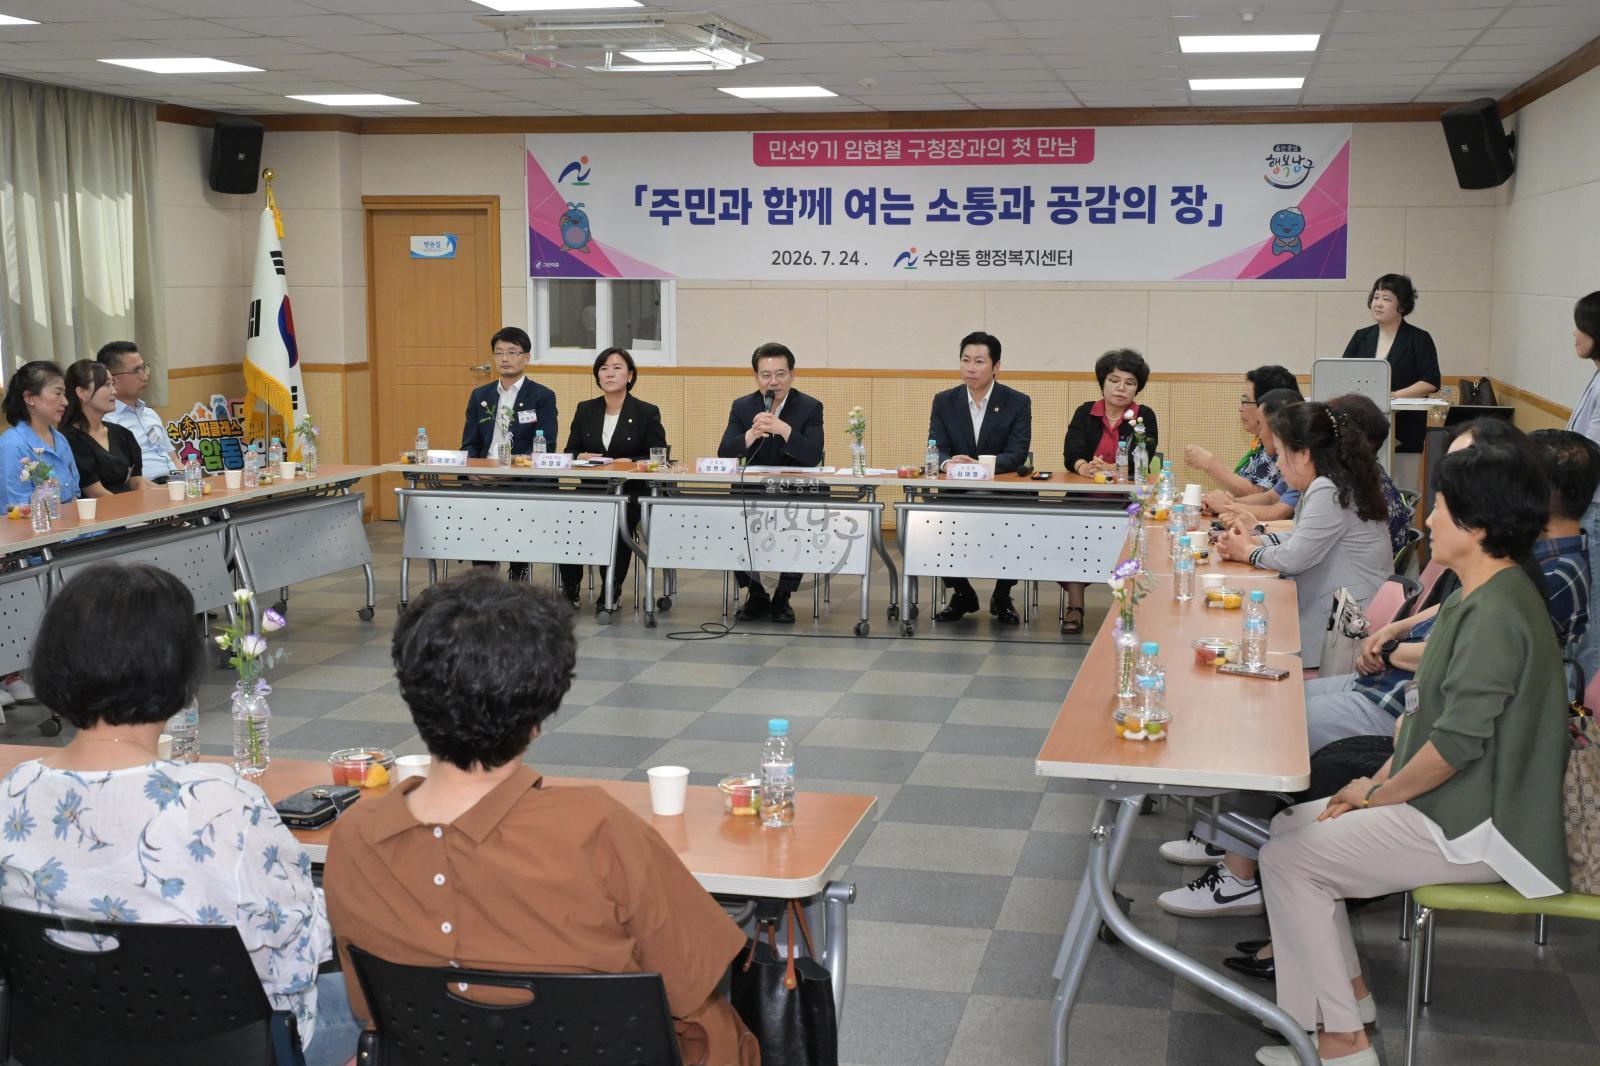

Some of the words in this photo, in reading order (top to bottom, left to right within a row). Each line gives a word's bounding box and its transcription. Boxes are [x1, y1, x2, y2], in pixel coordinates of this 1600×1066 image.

[768, 139, 838, 161] 민선9기
[844, 139, 902, 161] 임현철
[907, 138, 1006, 160] 구청장과의
[1013, 138, 1032, 158] 첫
[1037, 137, 1078, 158] 만남
[634, 184, 753, 226] 「주민과
[763, 186, 832, 226] 함께
[844, 186, 915, 226] 여는
[926, 185, 1035, 226] 소통과
[1046, 184, 1157, 226] 공감의
[1170, 184, 1223, 228] 장」
[923, 249, 971, 268] 수암동
[975, 249, 1074, 268] 행정복지센터
[179, 437, 245, 472] 수암동
